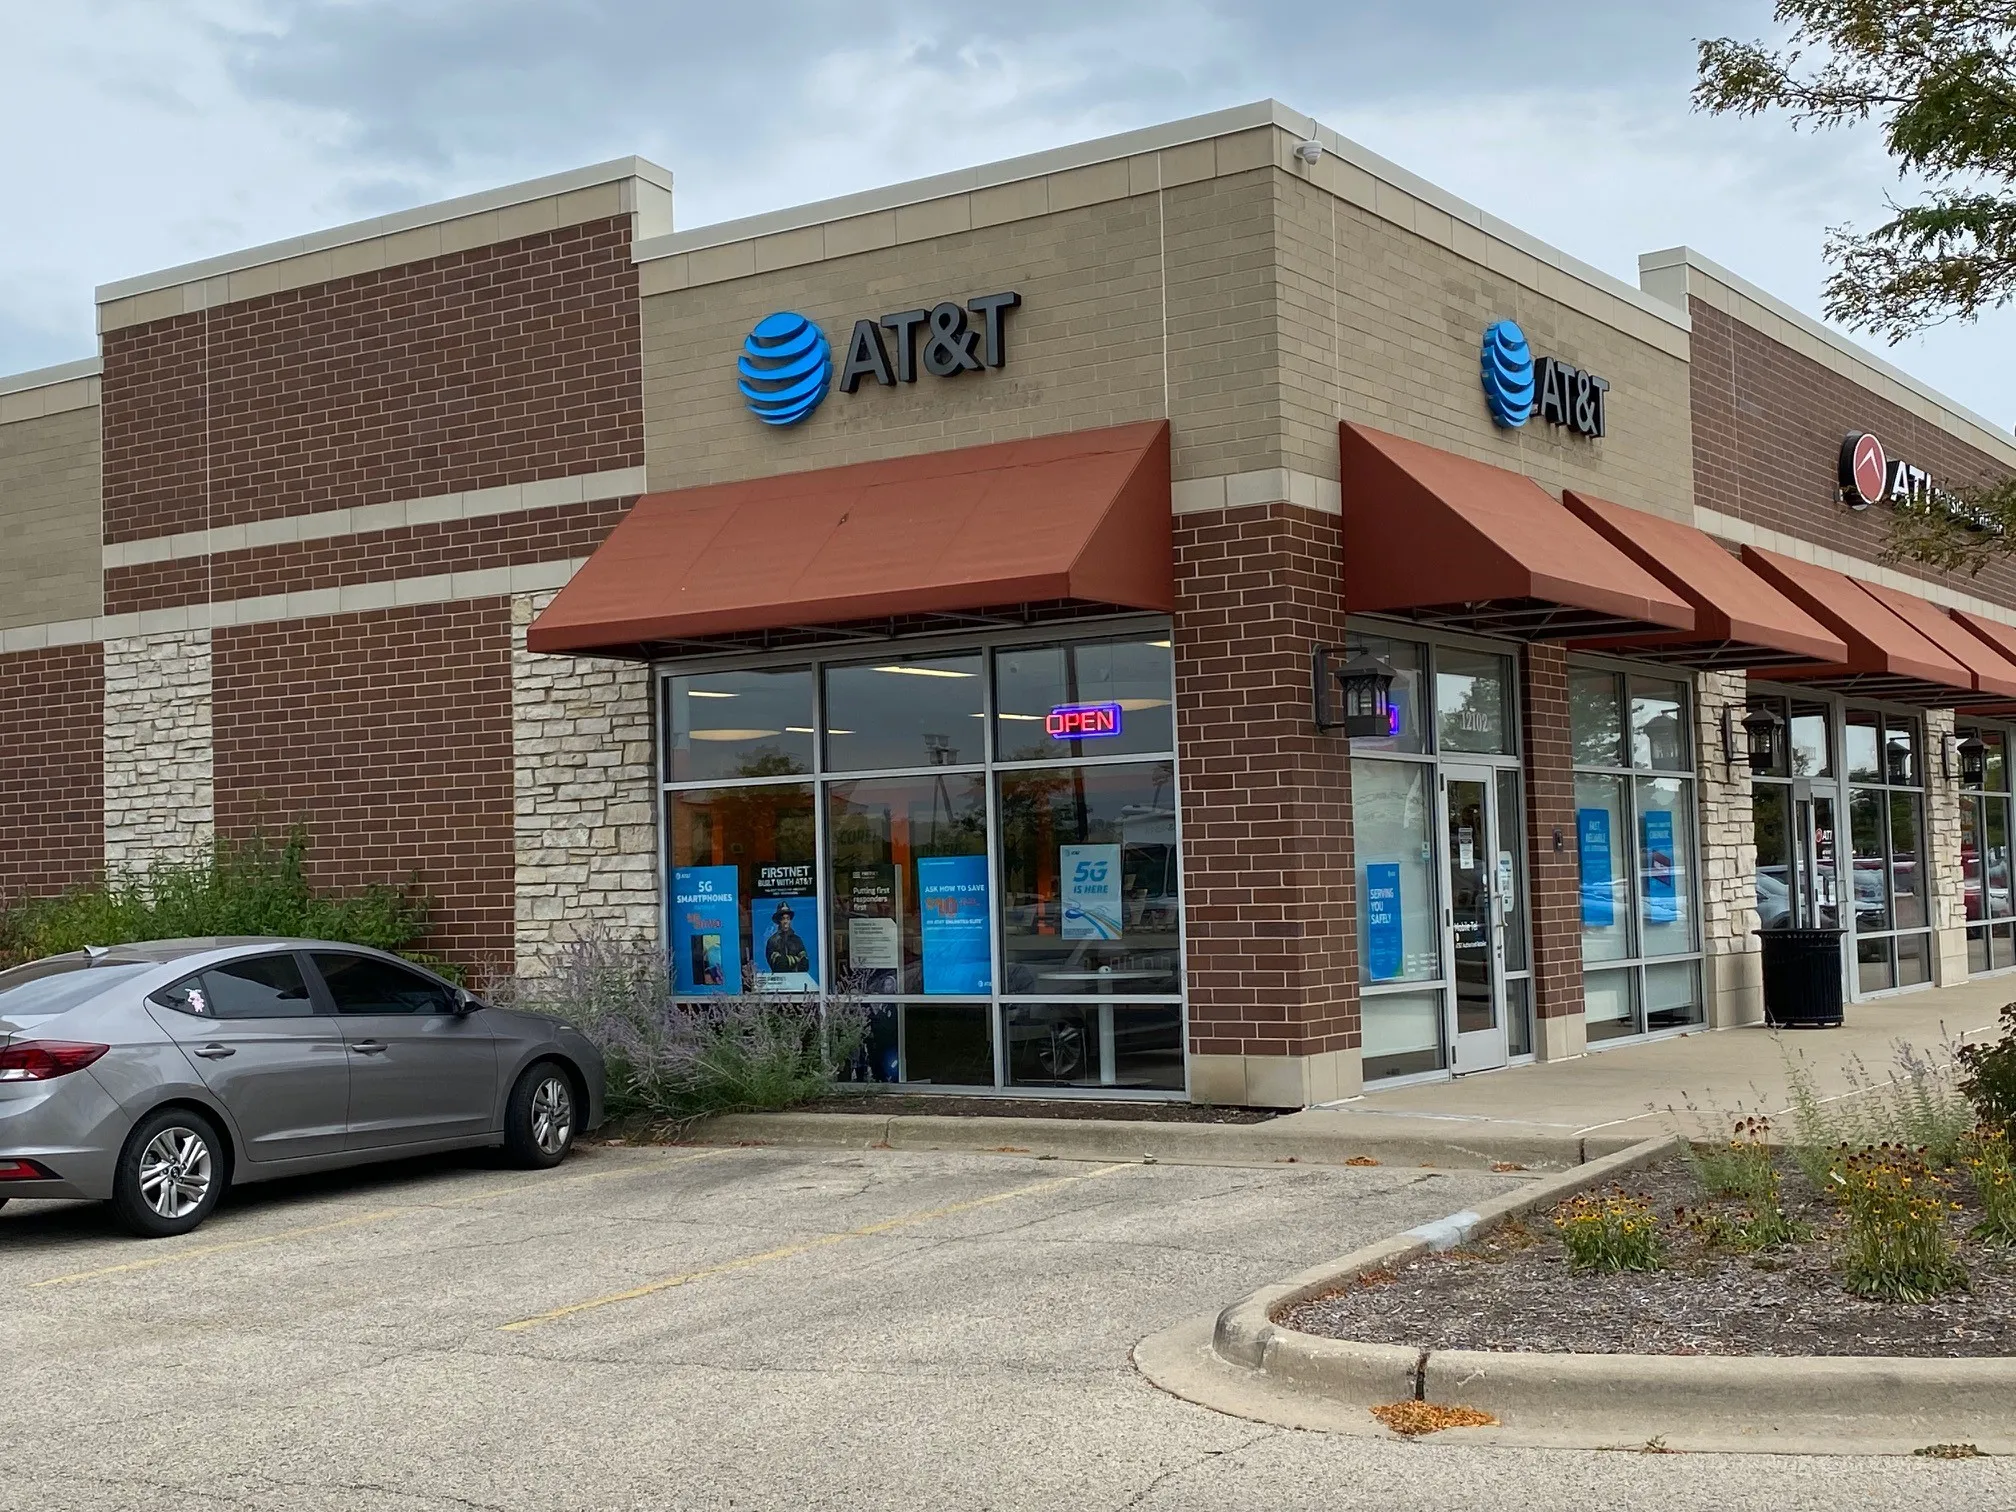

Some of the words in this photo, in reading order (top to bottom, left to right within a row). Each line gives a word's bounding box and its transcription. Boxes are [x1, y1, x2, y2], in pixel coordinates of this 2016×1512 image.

[840, 291, 1021, 393] AT&T
[1538, 357, 1609, 438] AT&T
[1890, 461, 1931, 514] ATI
[1046, 710, 1114, 734] OPEN
[1461, 711, 1488, 732] 12102
[762, 866, 811, 878] FIRSTNET
[1073, 861, 1108, 882] 5G
[699, 881, 713, 892] 5G
[795, 878, 813, 886] AT&T
[853, 887, 876, 895] Putting
[1084, 885, 1108, 893] HERE
[1370, 888, 1394, 899] SERVING
[677, 894, 733, 903] SMARTPHONES
[1371, 901, 1384, 911] YOU
[1371, 913, 1392, 924] SAFELY
